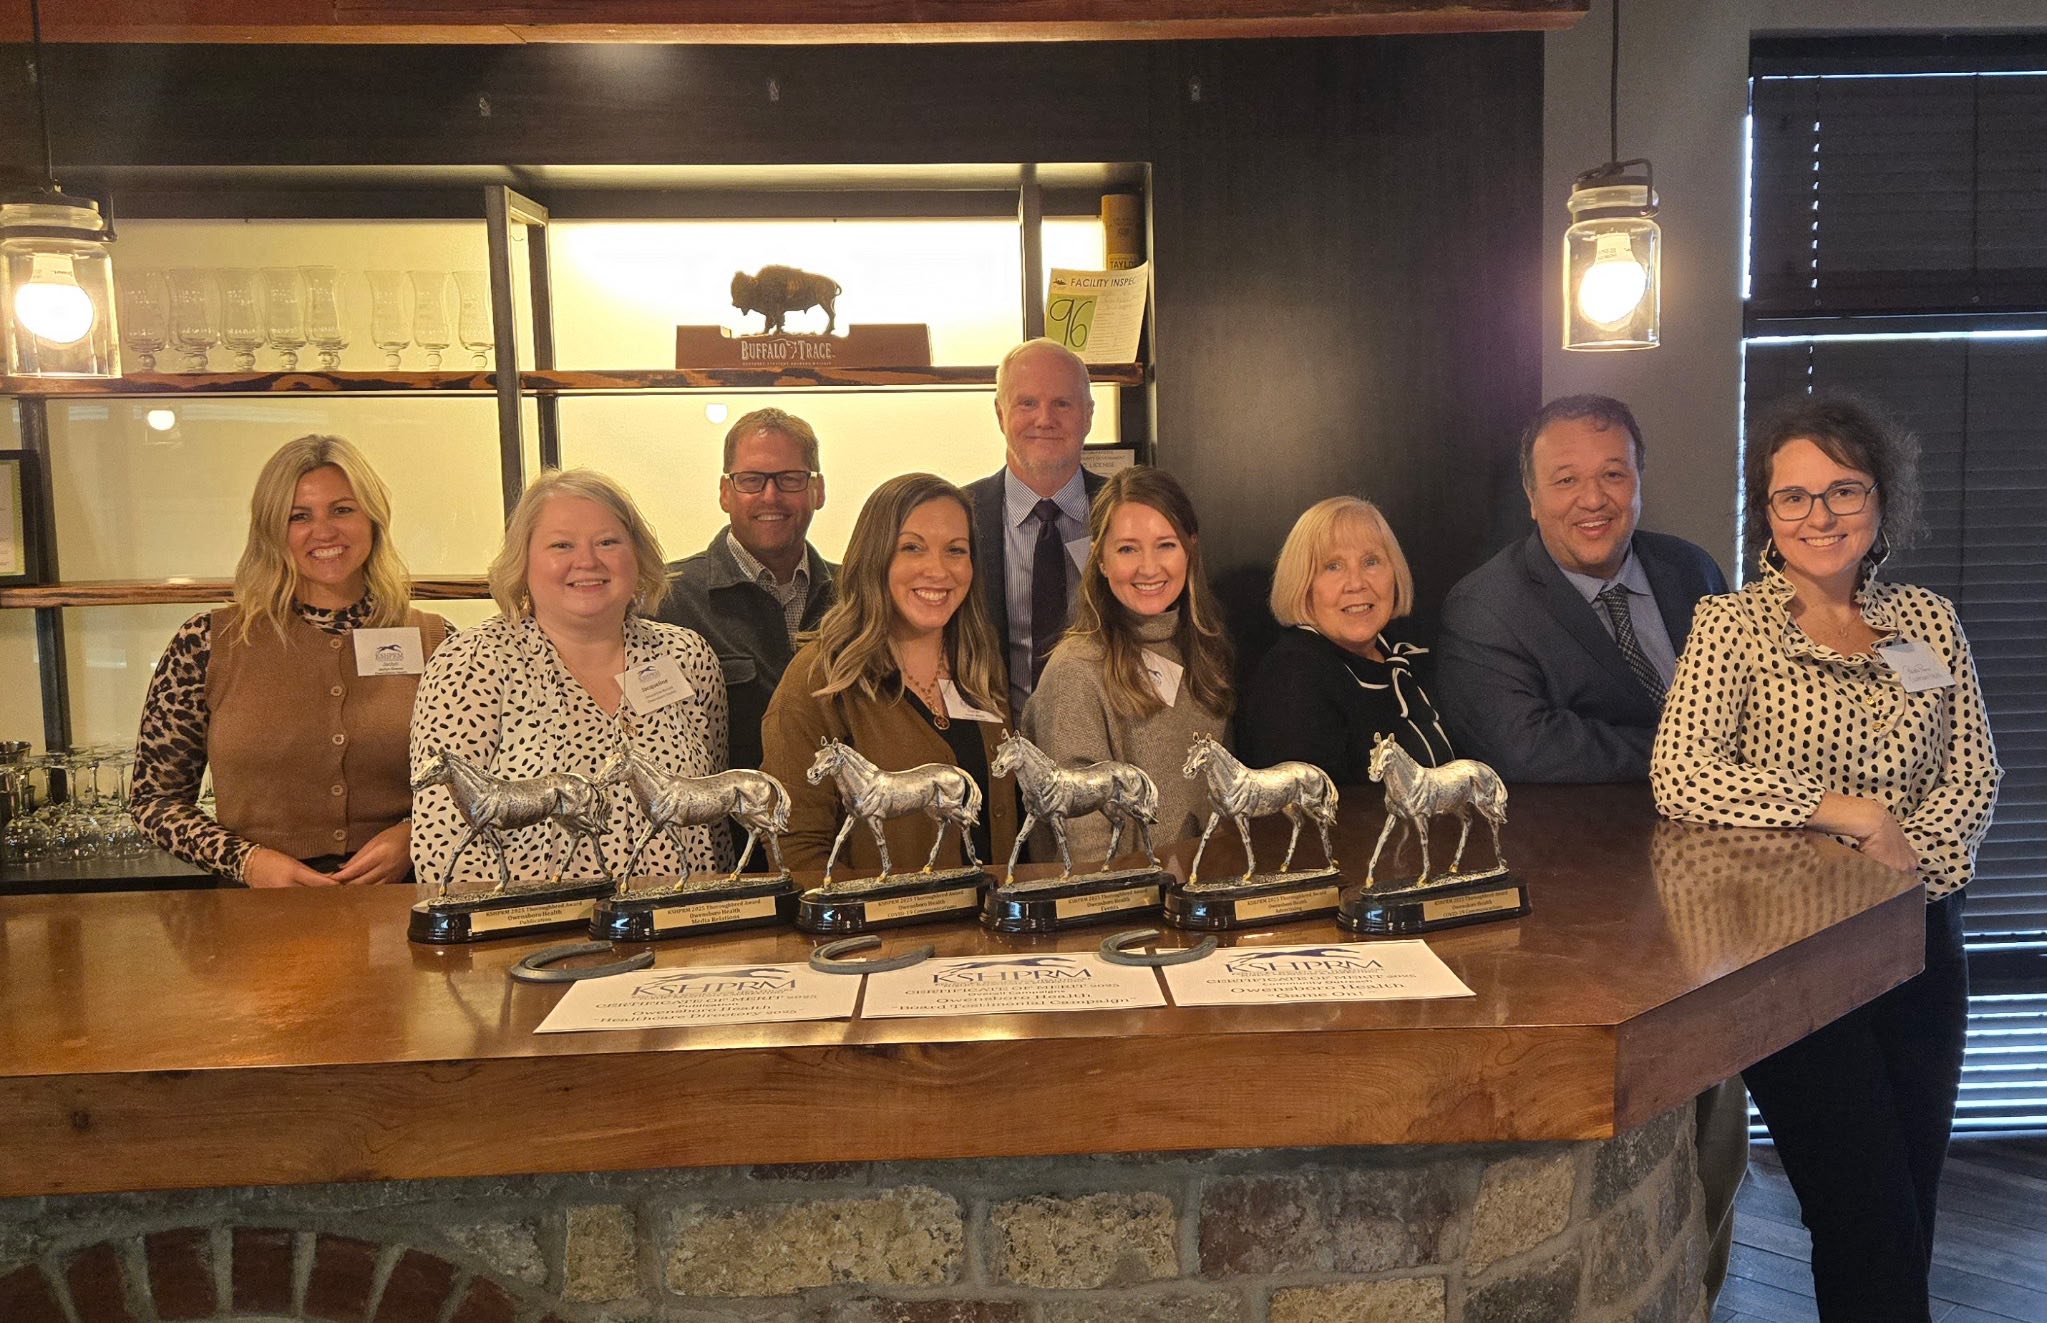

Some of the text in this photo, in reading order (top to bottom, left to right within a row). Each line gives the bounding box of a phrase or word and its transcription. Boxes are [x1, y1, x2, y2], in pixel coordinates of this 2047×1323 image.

[1070, 278, 1108, 288] FACILITY
[1049, 298, 1093, 348] 96
[741, 339, 832, 361] BUFFALO TRACE
[914, 892, 948, 902] Thoroughbred
[706, 900, 744, 910] Thoroughbred
[898, 902, 928, 911] Owensboro
[507, 909, 562, 921] Owensboro Health
[689, 907, 741, 919] Owensboro Health
[887, 910, 914, 918] COVID-19
[711, 914, 740, 923] Relations
[1225, 959, 1383, 973] KSHPRM
[933, 968, 1092, 983] KSHPRM
[1206, 976, 1308, 984] CERTIFICATE
[632, 979, 796, 996] KSHPRM
[905, 986, 1008, 995] CERTIFICATE
[1230, 985, 1336, 994] Owensboro
[595, 998, 704, 1008] CERTIFICATE
[632, 1004, 772, 1016] Owensboro Health
[690, 1010, 762, 1019] Directory
